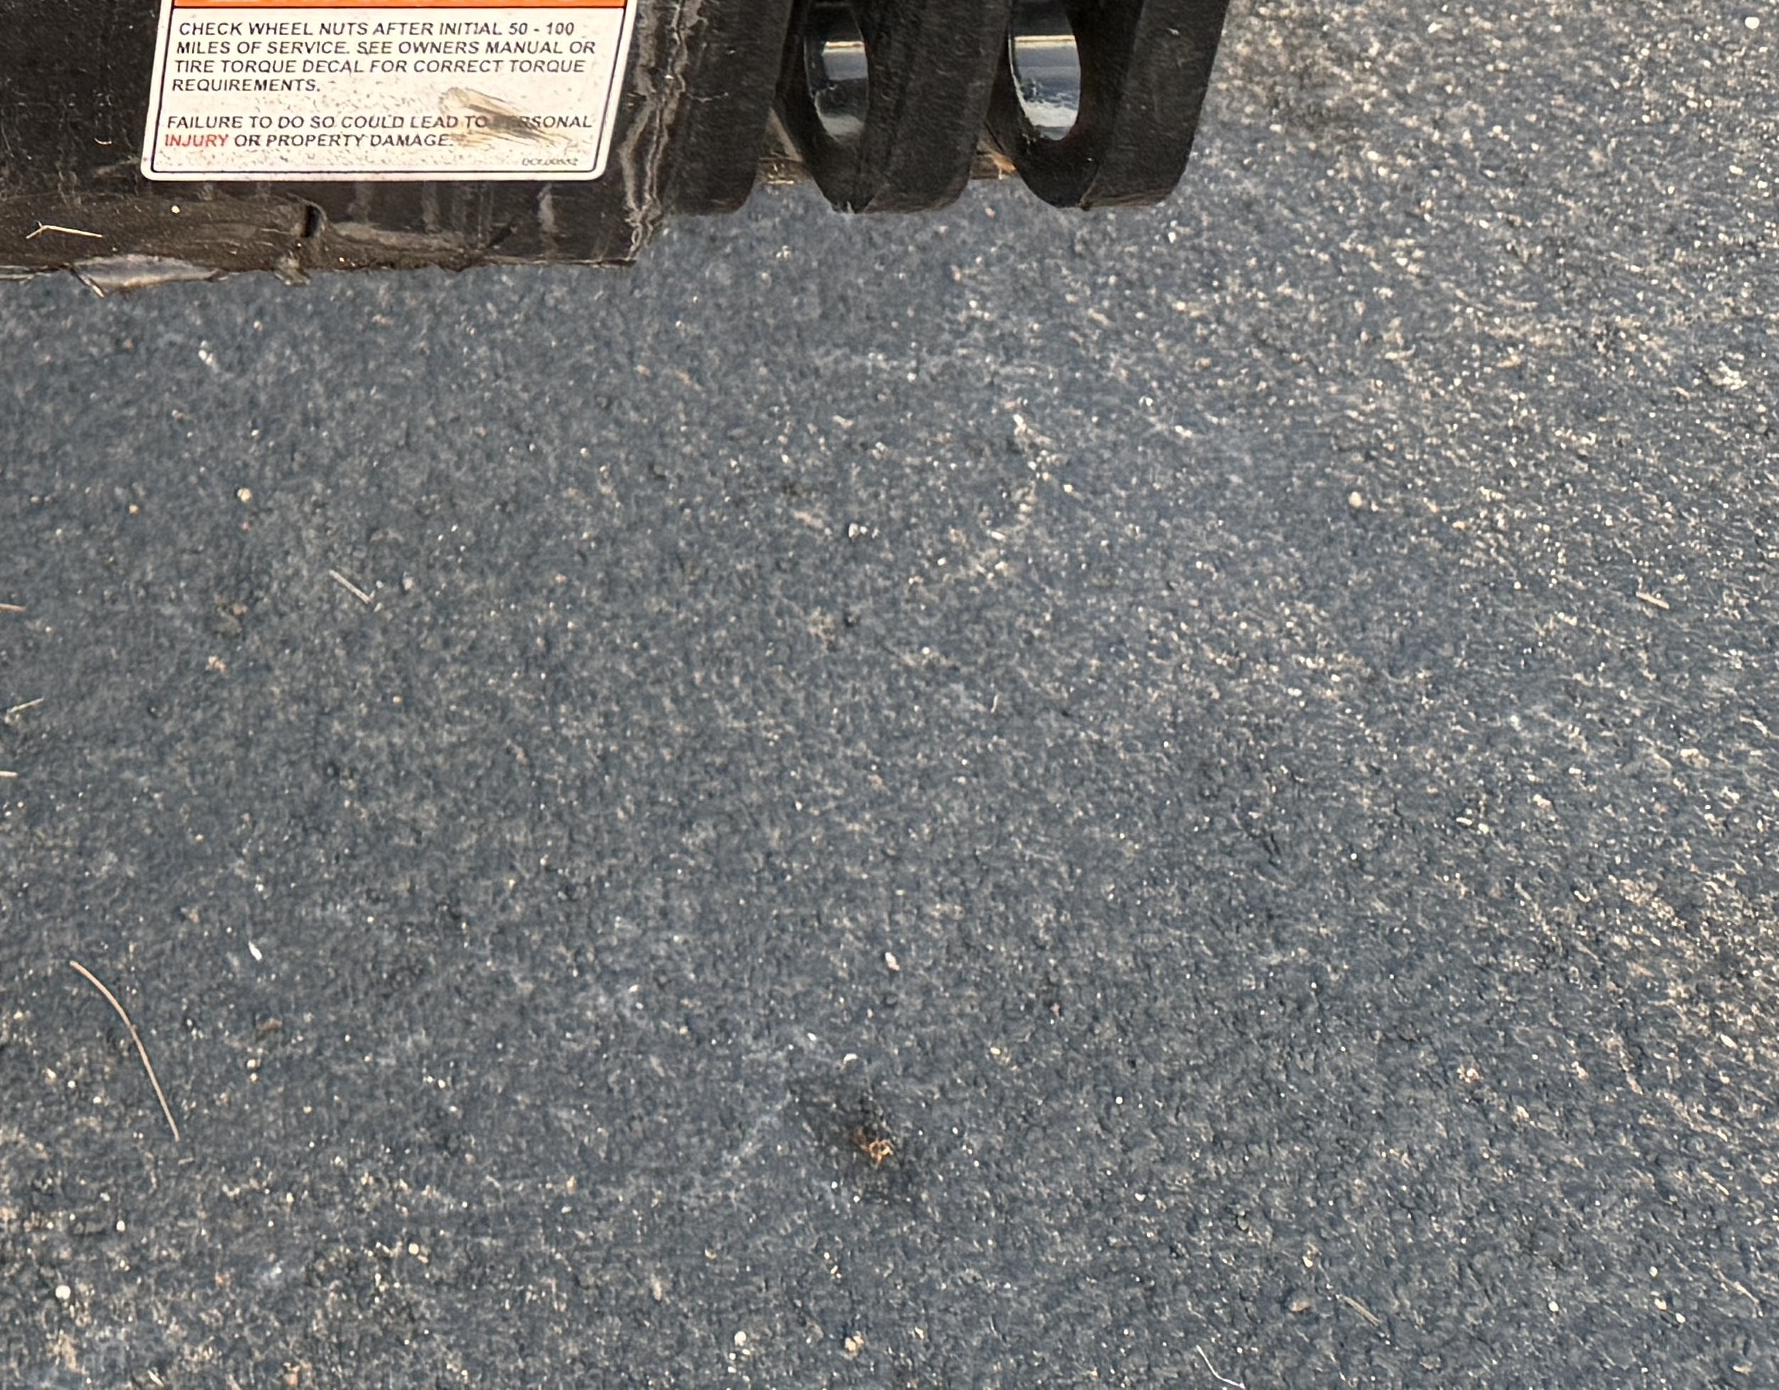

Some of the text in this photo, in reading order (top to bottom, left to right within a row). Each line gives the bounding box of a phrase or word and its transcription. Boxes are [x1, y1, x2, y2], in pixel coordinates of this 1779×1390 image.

[179, 22, 243, 35] CHECK
[248, 22, 314, 35] WHEEL
[319, 22, 368, 35] NUTS
[372, 22, 433, 35] AFTER
[439, 22, 502, 35] INITIAL
[508, 22, 528, 35] 50
[546, 22, 575, 36] 100
[176, 41, 596, 55] MILES OF SERVICE. SEE OWNERS MANUAL OR
[174, 60, 587, 73] TIRE TORQUE DECAL FOR CORRECT TORQUE
[172, 79, 321, 92] REQUIREMENTS.
[167, 115, 593, 129] FAILURE TO DO SO COULD LEAD TO RSONAL
[164, 134, 454, 147] INJURY OR PROPERTY DAMAGE.
